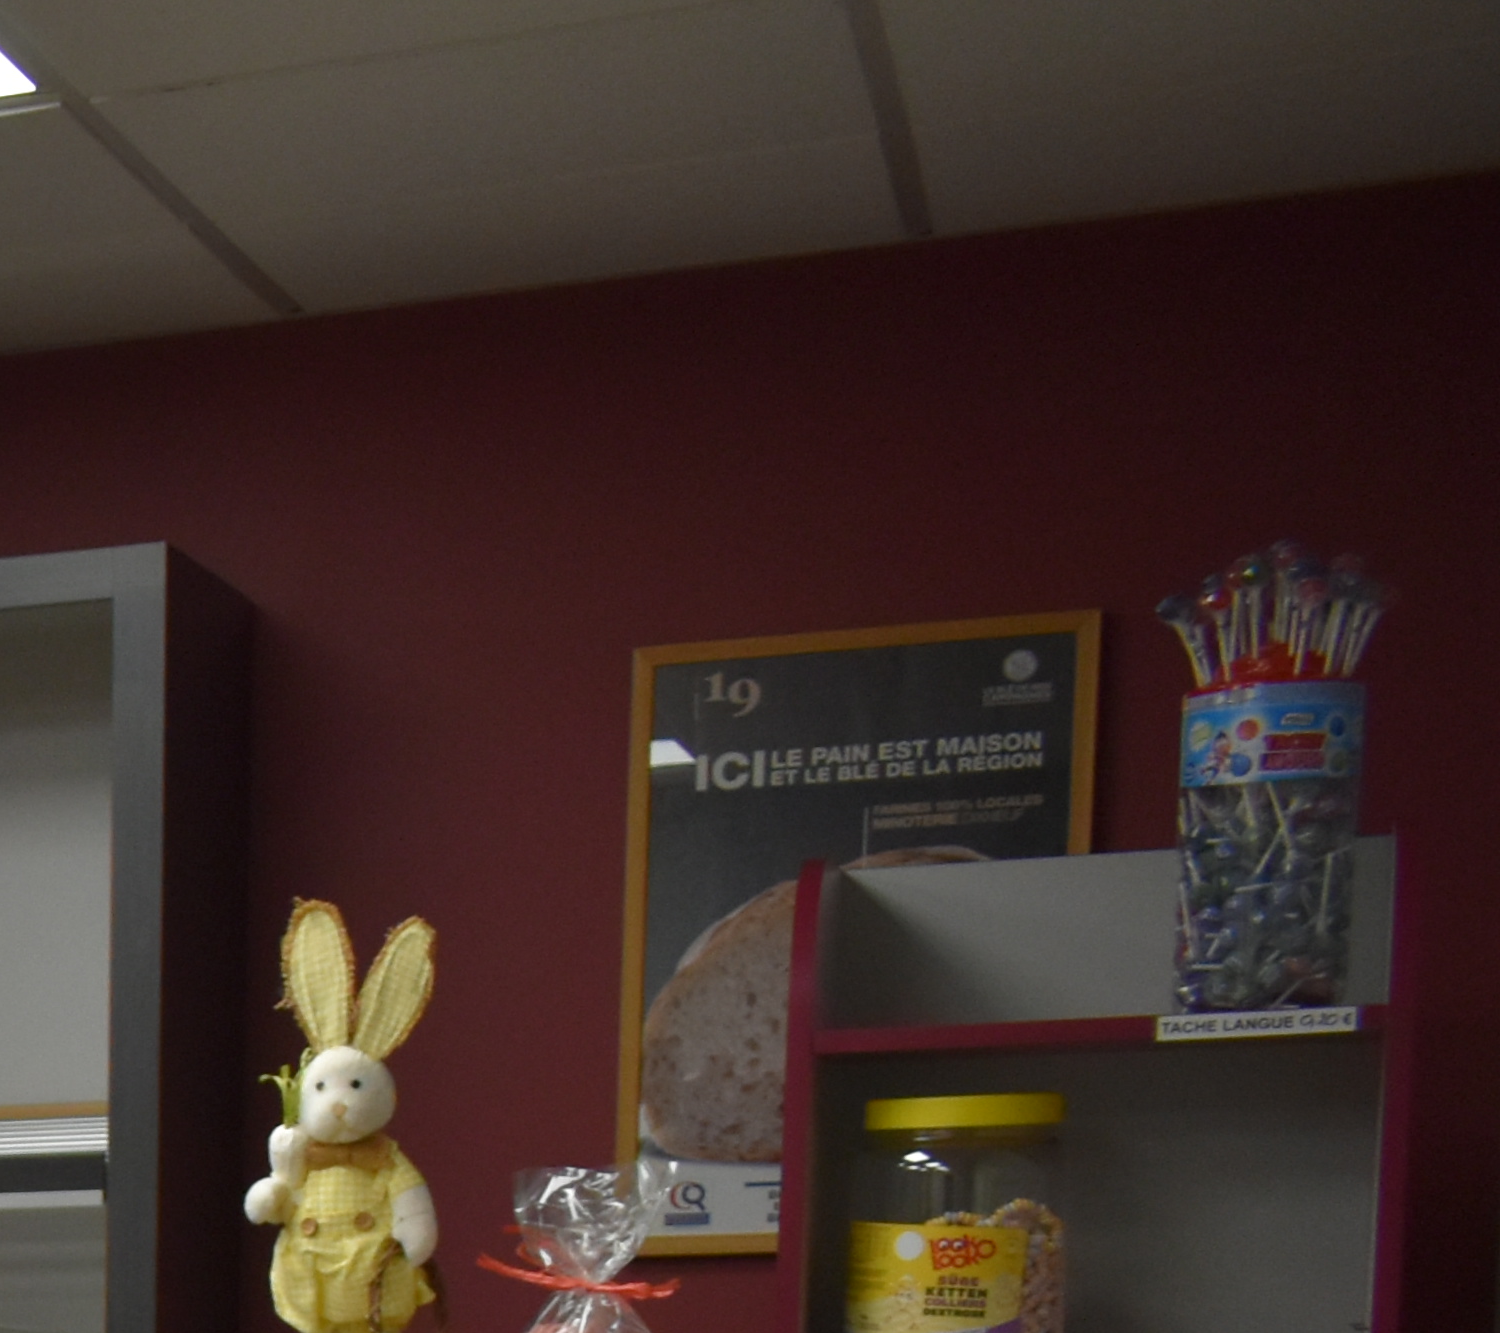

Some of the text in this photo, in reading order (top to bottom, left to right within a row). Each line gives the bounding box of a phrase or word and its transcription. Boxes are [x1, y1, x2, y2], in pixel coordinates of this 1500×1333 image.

[705, 672, 760, 717] 19
[771, 731, 1042, 769] LE PAIN EST MAISON
[771, 751, 1042, 785] ET LE BLÉ DE LA RÉGION
[696, 750, 765, 791] ICI
[1162, 1019, 1218, 1035] TACHE
[1222, 1016, 1294, 1031] LANGUE
[926, 1287, 988, 1299] KETTEN
